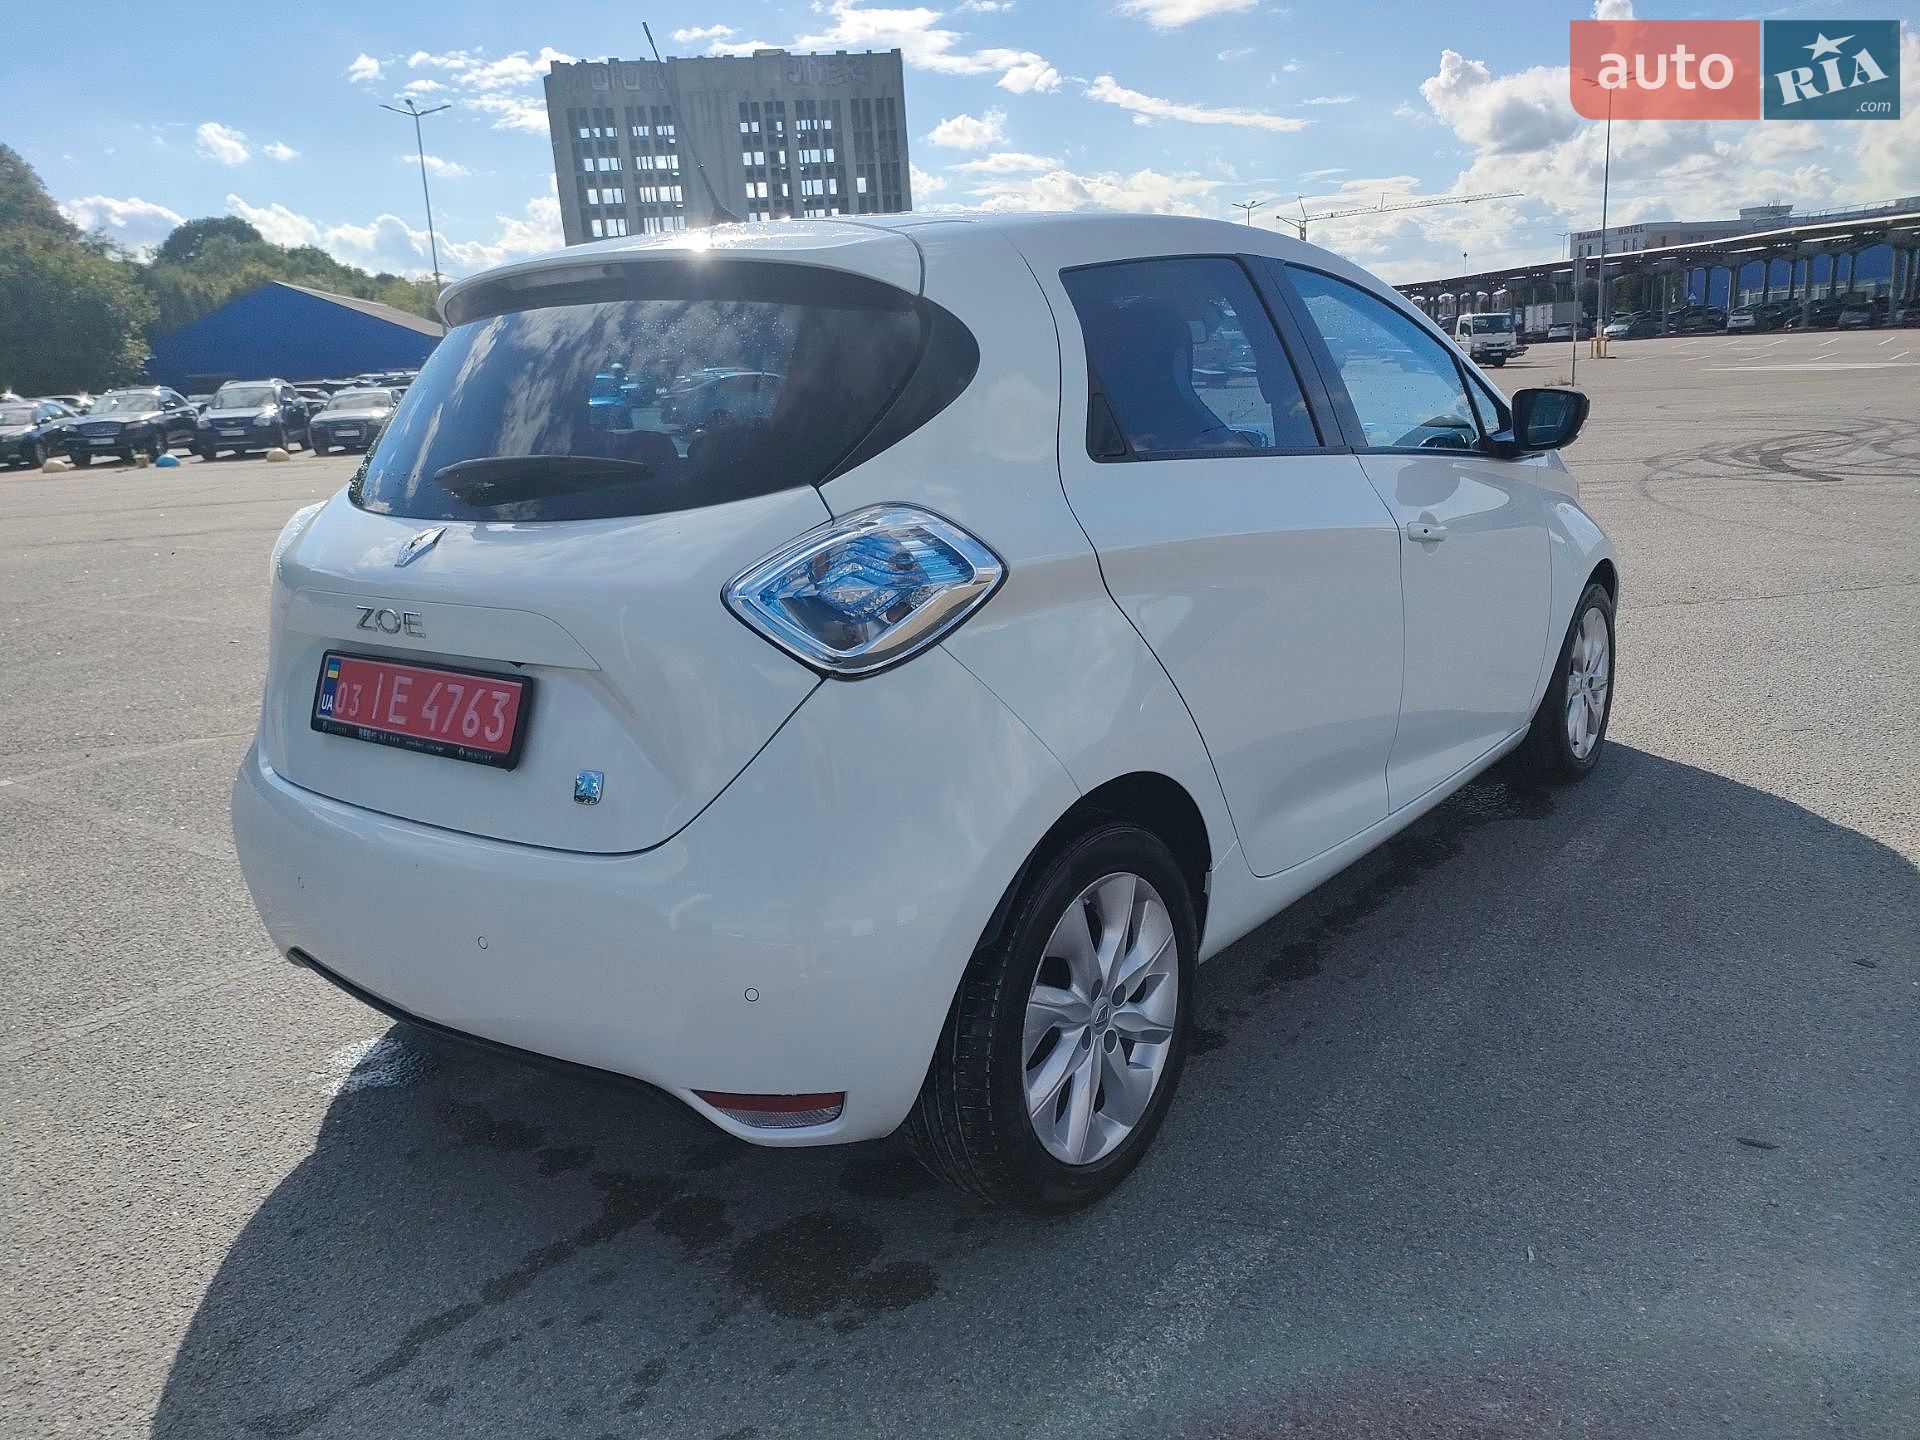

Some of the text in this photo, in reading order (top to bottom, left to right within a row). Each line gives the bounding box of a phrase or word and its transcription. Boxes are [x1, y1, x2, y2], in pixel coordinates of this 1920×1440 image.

[1578, 224, 1645, 241] RAMAD HOTEL
[356, 605, 427, 639] ZOE
[321, 694, 333, 710] UA
[335, 672, 511, 743] 03 IE 4763
